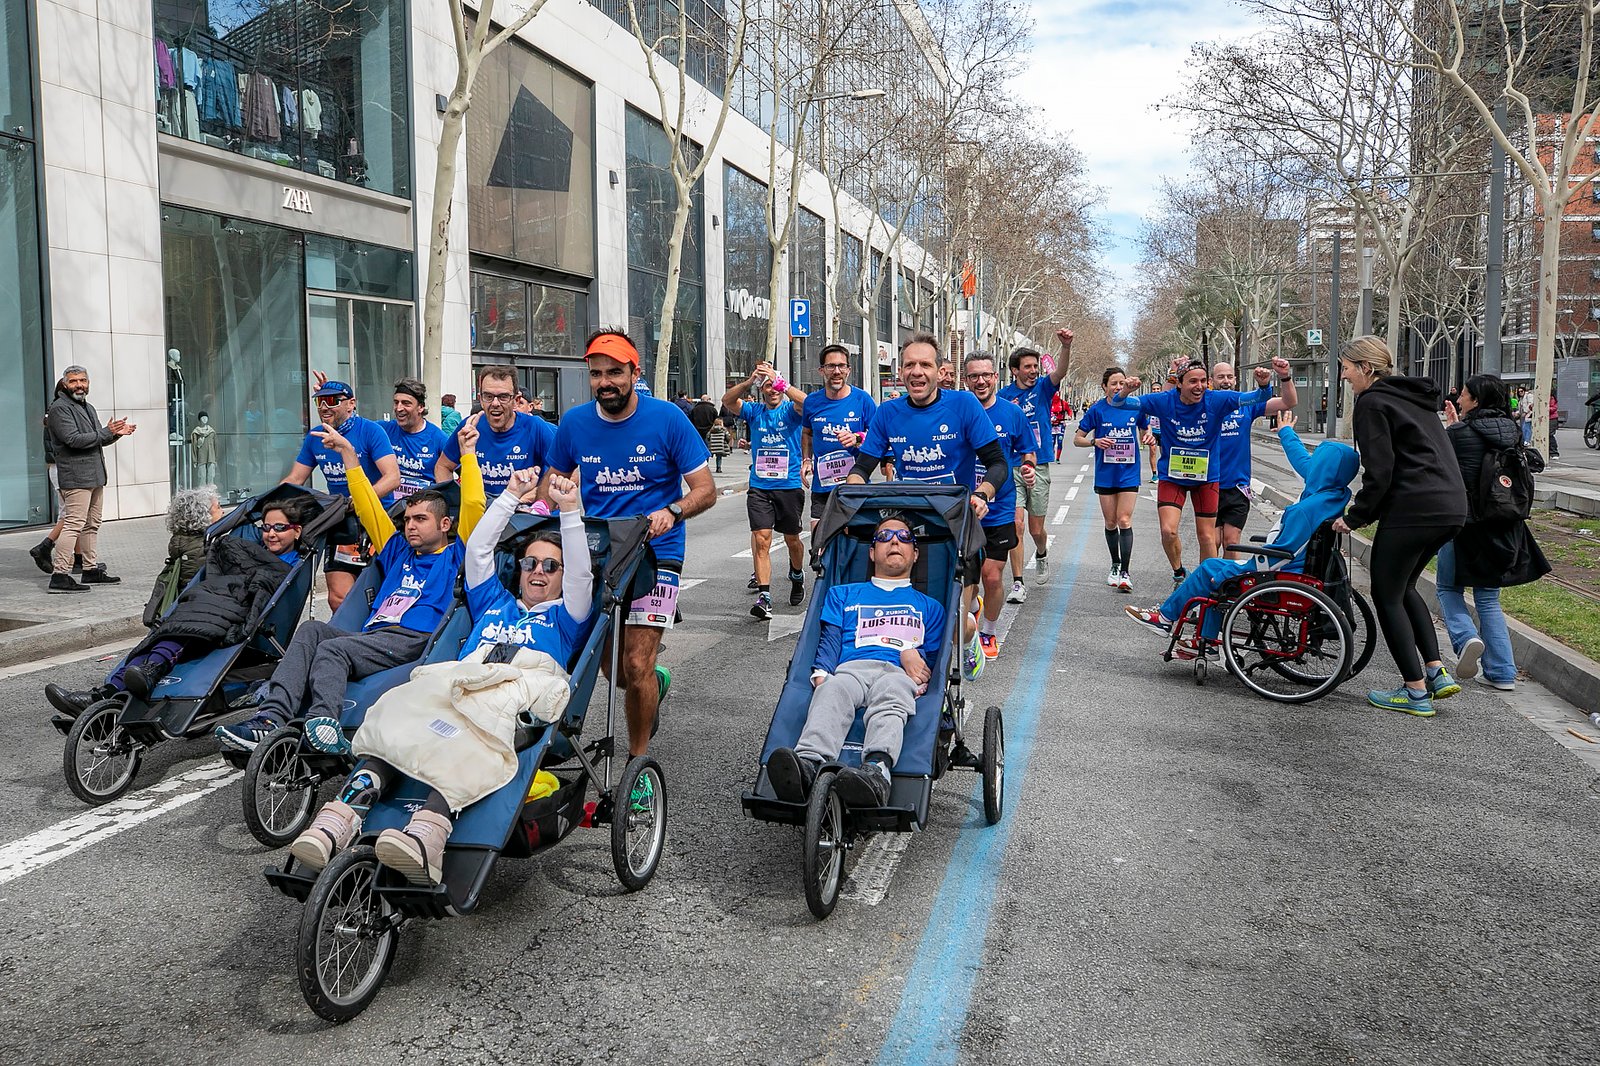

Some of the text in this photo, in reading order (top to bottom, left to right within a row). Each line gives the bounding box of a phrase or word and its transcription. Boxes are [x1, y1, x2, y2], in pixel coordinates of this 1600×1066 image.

[282, 187, 313, 213] ZARA
[794, 302, 806, 321] P
[629, 455, 656, 463] ZURICH
[826, 460, 846, 470] PABLO
[905, 464, 945, 472] #Imparables
[598, 483, 645, 493] #Imparables
[650, 599, 661, 607] 523
